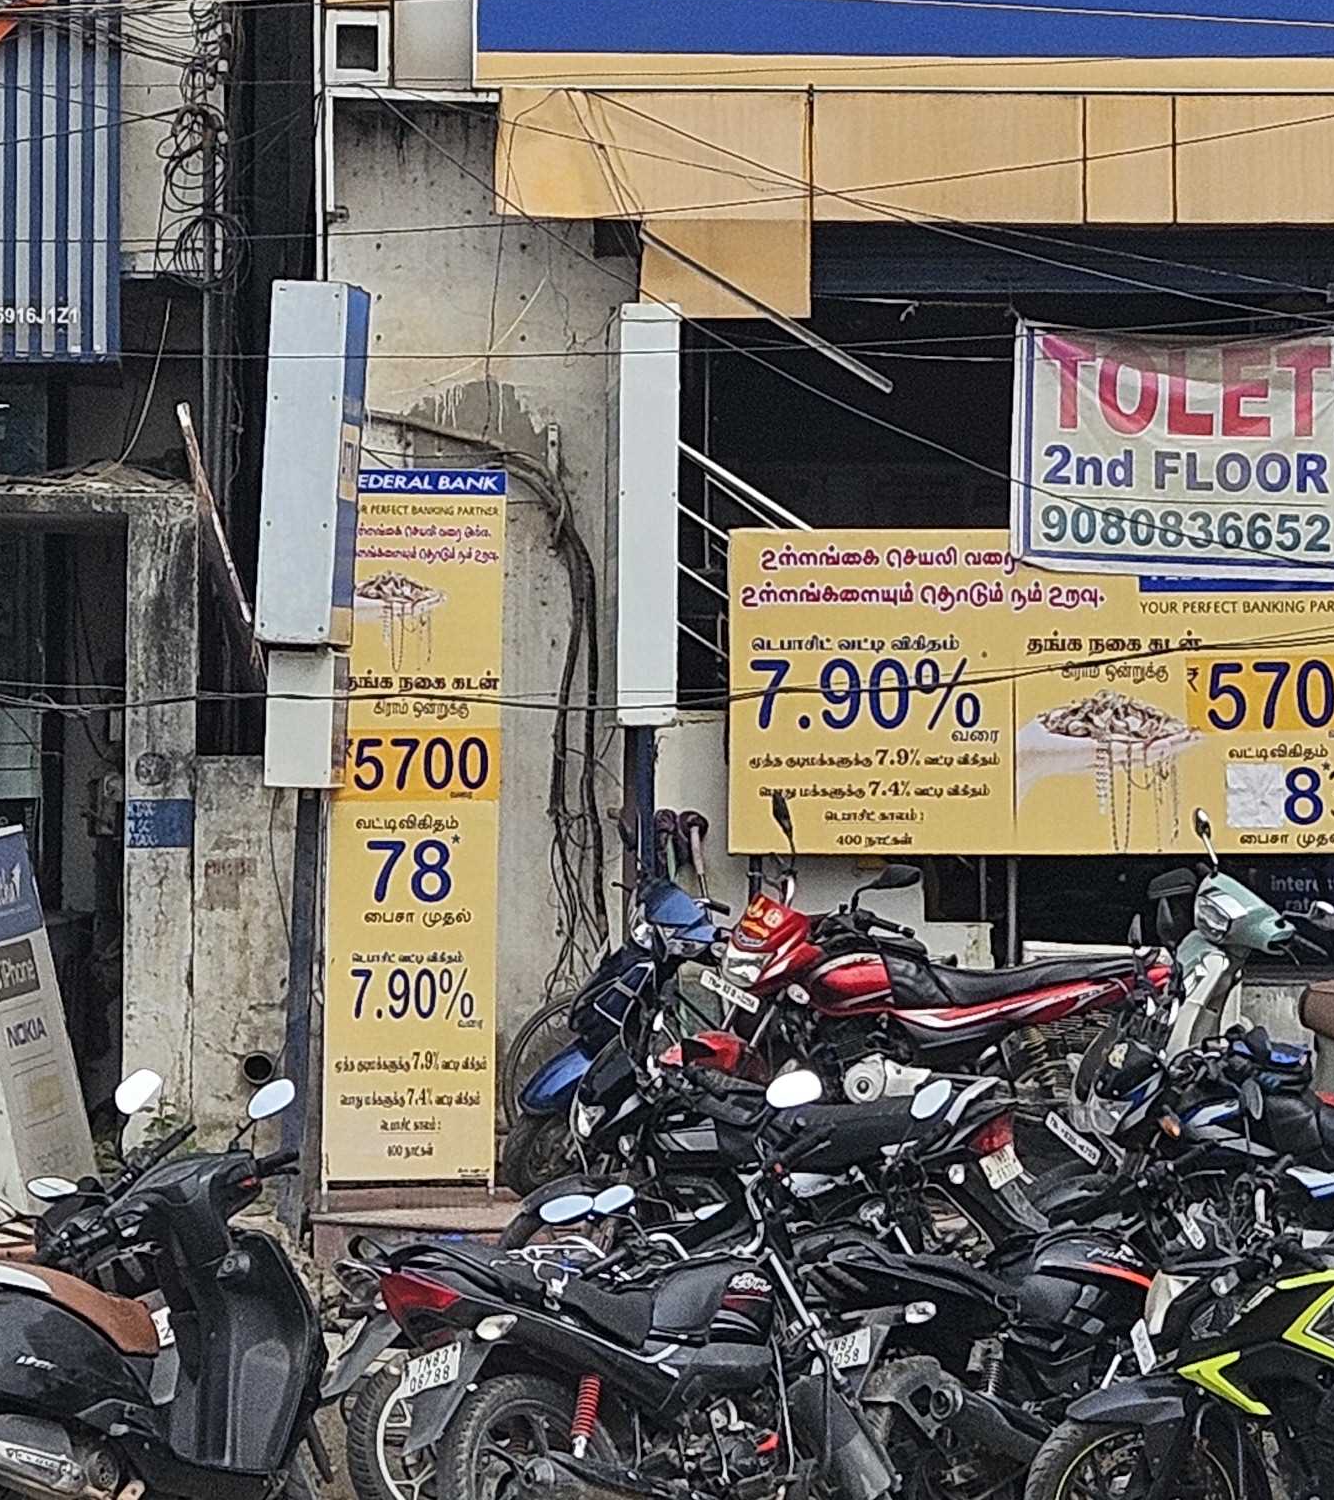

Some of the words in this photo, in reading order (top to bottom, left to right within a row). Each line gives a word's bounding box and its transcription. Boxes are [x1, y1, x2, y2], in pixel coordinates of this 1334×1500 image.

[1043, 445, 1133, 487] 2nd
[1155, 451, 1329, 493] FLOOR
[359, 474, 433, 490] EDERAL
[437, 473, 498, 491] BANK
[371, 505, 407, 516] PERFECT
[457, 505, 499, 516] PARTNER
[1041, 505, 1331, 552] 9080836652
[887, 547, 957, 570] செயலி
[920, 582, 1004, 611] தொடும்
[1012, 583, 1042, 610] நம்
[1141, 601, 1178, 614] YOUR
[1183, 601, 1237, 613] PERFECT
[1243, 601, 1306, 613] BANKING
[1027, 631, 1083, 654] தங்க
[1089, 639, 1142, 656] நகை
[398, 673, 446, 692] நகை
[451, 670, 500, 691] கடன்
[750, 658, 980, 730] 7.90%
[952, 729, 999, 744] வரை
[875, 749, 920, 766] 7.9%
[869, 780, 910, 797] 7.4%
[837, 835, 862, 845] 400
[1240, 833, 1289, 846] பைசா
[1285, 898, 1310, 911] rat
[364, 910, 415, 924] பைசா
[422, 909, 471, 928] முதல்
[0, 958, 36, 990] iPhone
[350, 967, 475, 1020] 7.90%
[5, 1017, 47, 1049] NOKIA
[418, 1349, 449, 1373] TN83
